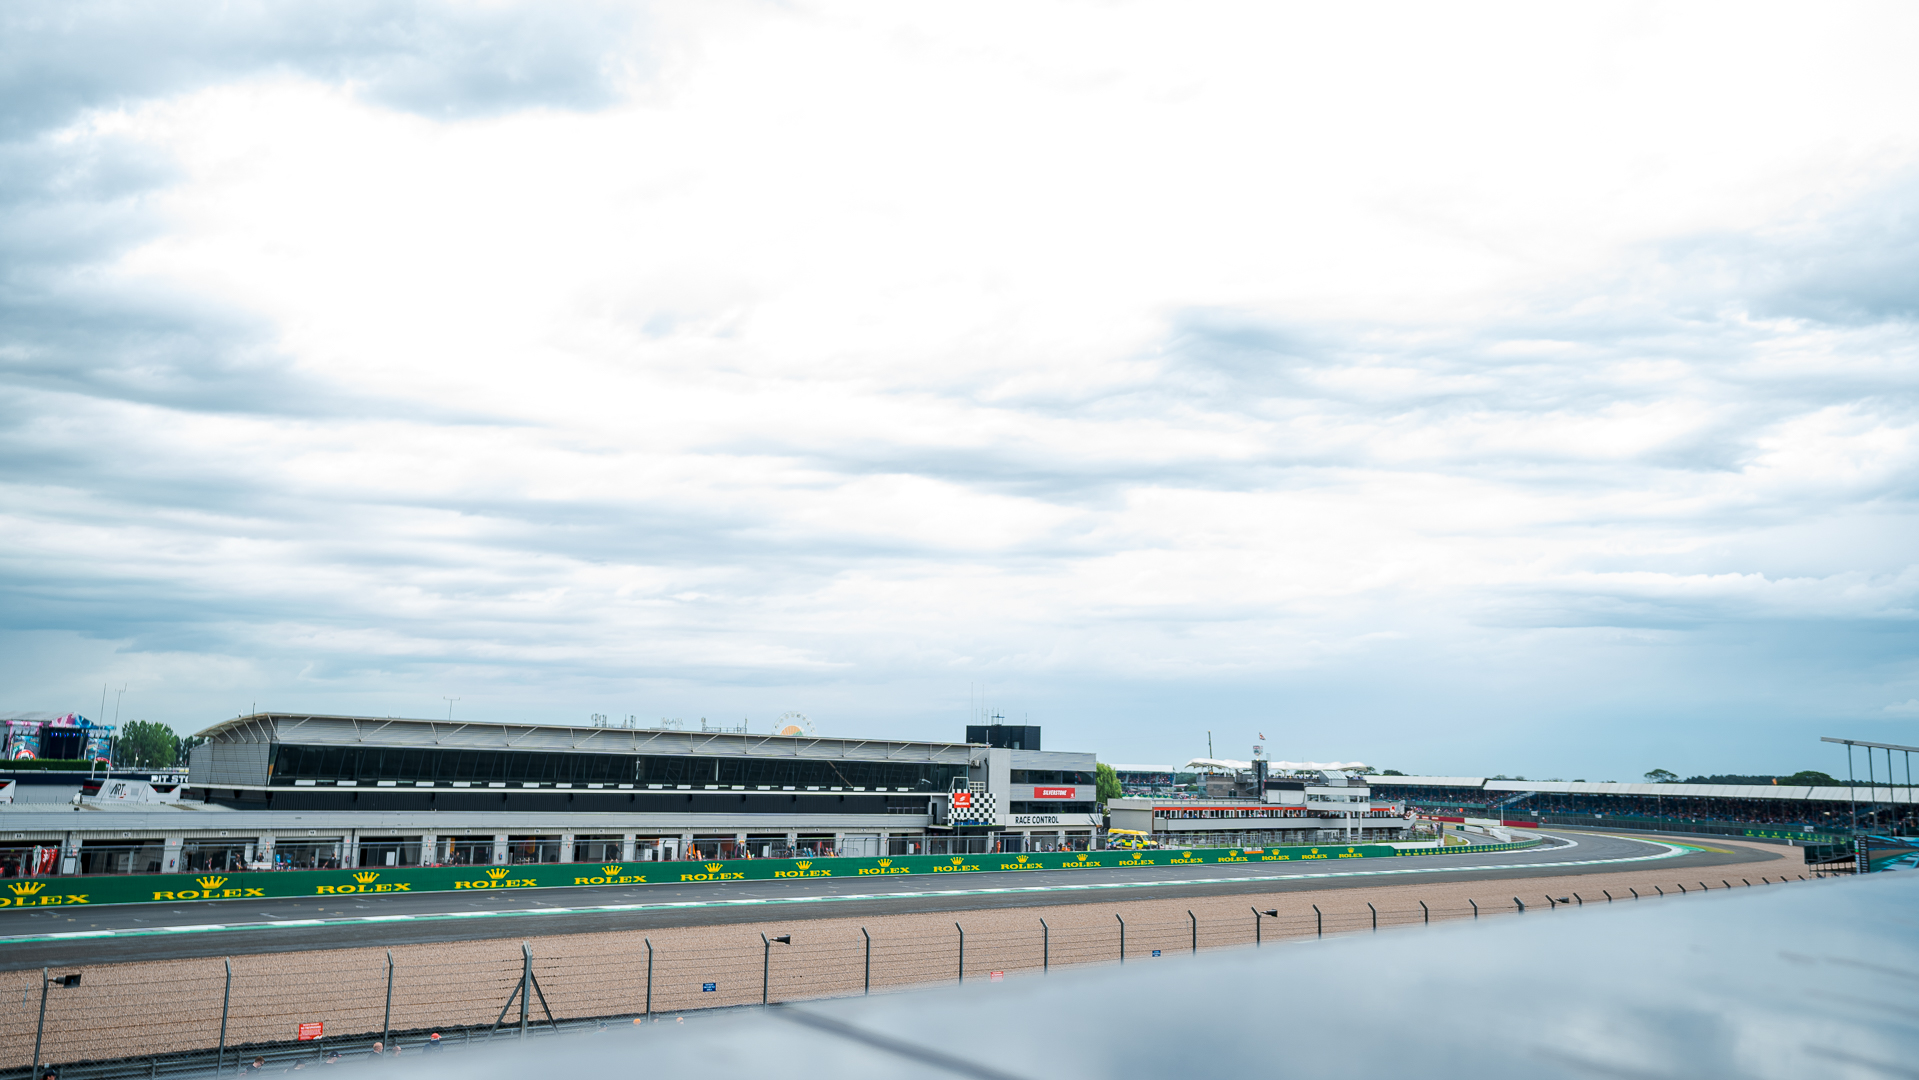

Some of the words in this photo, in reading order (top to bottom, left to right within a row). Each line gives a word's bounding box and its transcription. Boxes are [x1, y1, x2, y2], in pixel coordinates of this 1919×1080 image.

[150, 774, 169, 784] PIT
[1015, 815, 1031, 825] RACE
[1032, 815, 1060, 825] CONTROL
[1000, 862, 1044, 870] ROLEX
[1118, 859, 1155, 867] ROLEX
[774, 869, 832, 878] ROLEX
[858, 867, 910, 875] ROLEX
[933, 864, 980, 873] ROLEX
[574, 875, 647, 885] ROLEX
[680, 872, 745, 882] ROLEX
[316, 882, 412, 895] ROLEX
[454, 878, 537, 890] ROLEX
[152, 887, 265, 901] ROLEX
